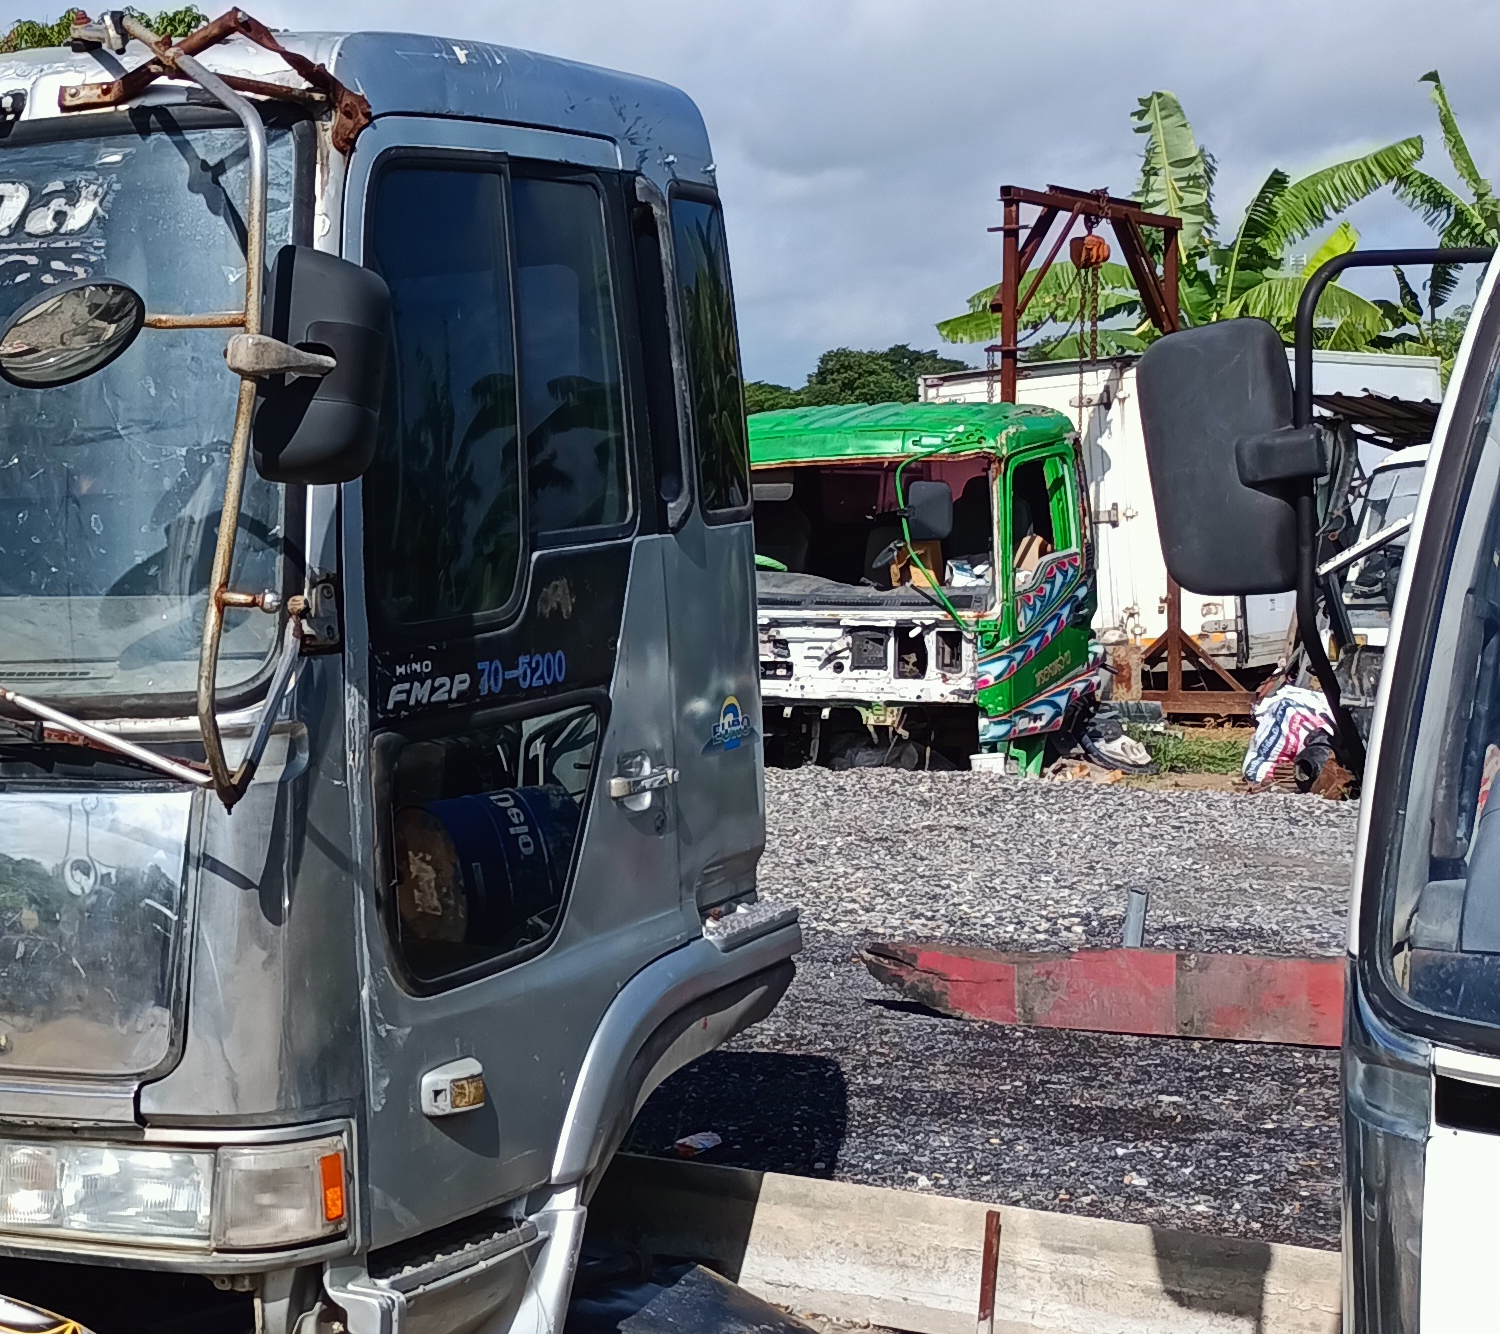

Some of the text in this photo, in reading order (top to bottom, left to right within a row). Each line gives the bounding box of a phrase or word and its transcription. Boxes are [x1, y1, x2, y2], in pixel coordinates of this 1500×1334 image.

[395, 660, 432, 677] HINO
[477, 649, 566, 696] 70-5200
[386, 673, 471, 710] FM2P
